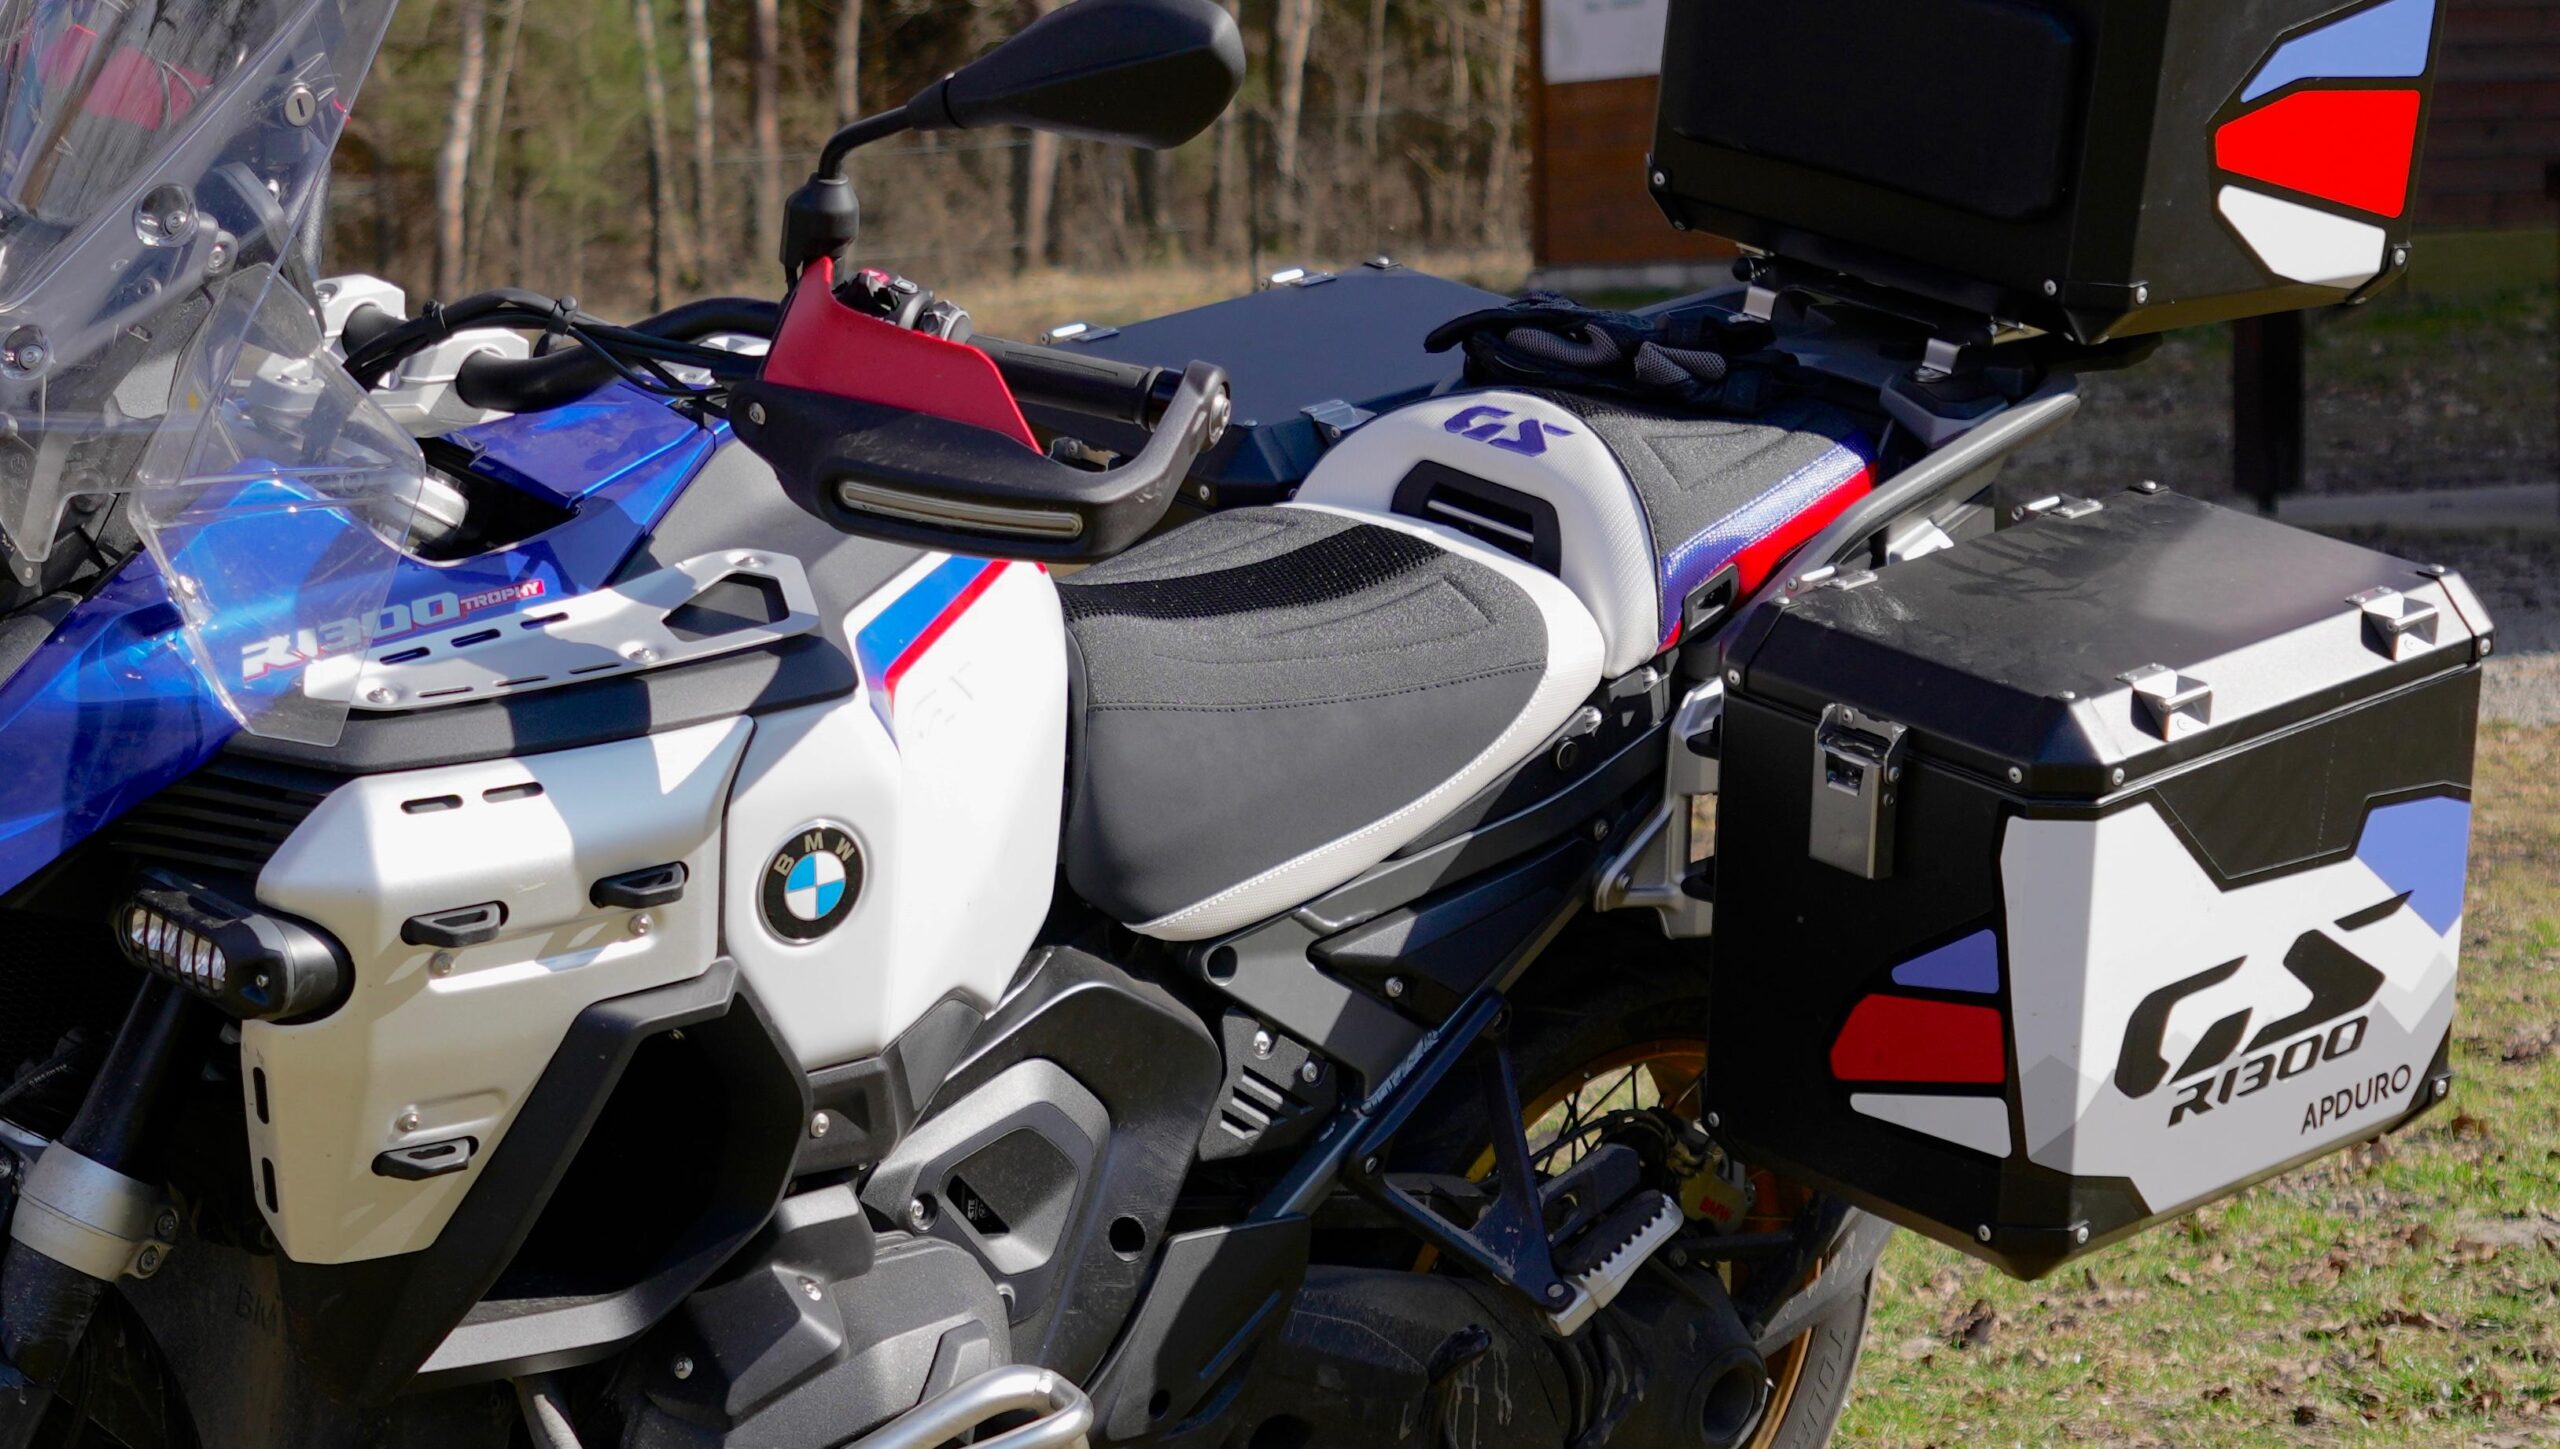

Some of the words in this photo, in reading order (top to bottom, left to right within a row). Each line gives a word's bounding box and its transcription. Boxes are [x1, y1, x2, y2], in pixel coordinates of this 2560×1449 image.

[1444, 405, 1576, 458] GS
[241, 591, 461, 681] R1300
[460, 580, 542, 612] TROPHY
[773, 831, 856, 877] BMW
[2113, 889, 2415, 1099] GS
[2167, 1015, 2369, 1128] R1300
[2300, 1063, 2412, 1137] APDURO
